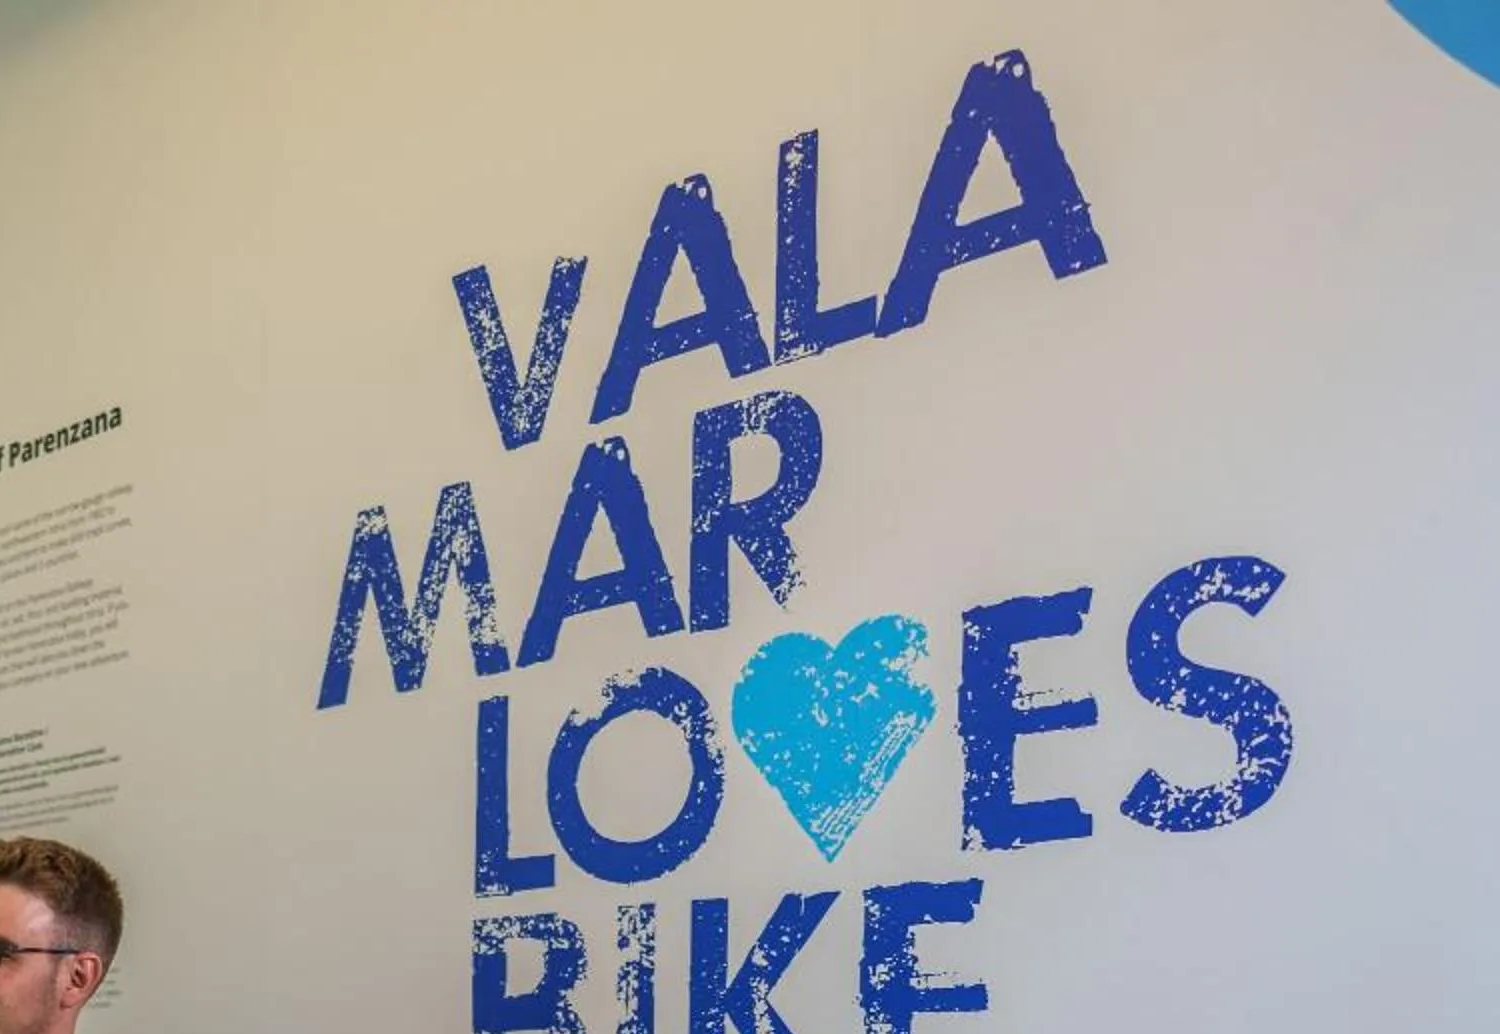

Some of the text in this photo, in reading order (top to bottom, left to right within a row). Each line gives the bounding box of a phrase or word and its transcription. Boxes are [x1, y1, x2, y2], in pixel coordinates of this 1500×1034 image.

[453, 47, 1109, 451] VALA
[8, 405, 123, 468] Parenzana
[317, 390, 824, 709] MAR
